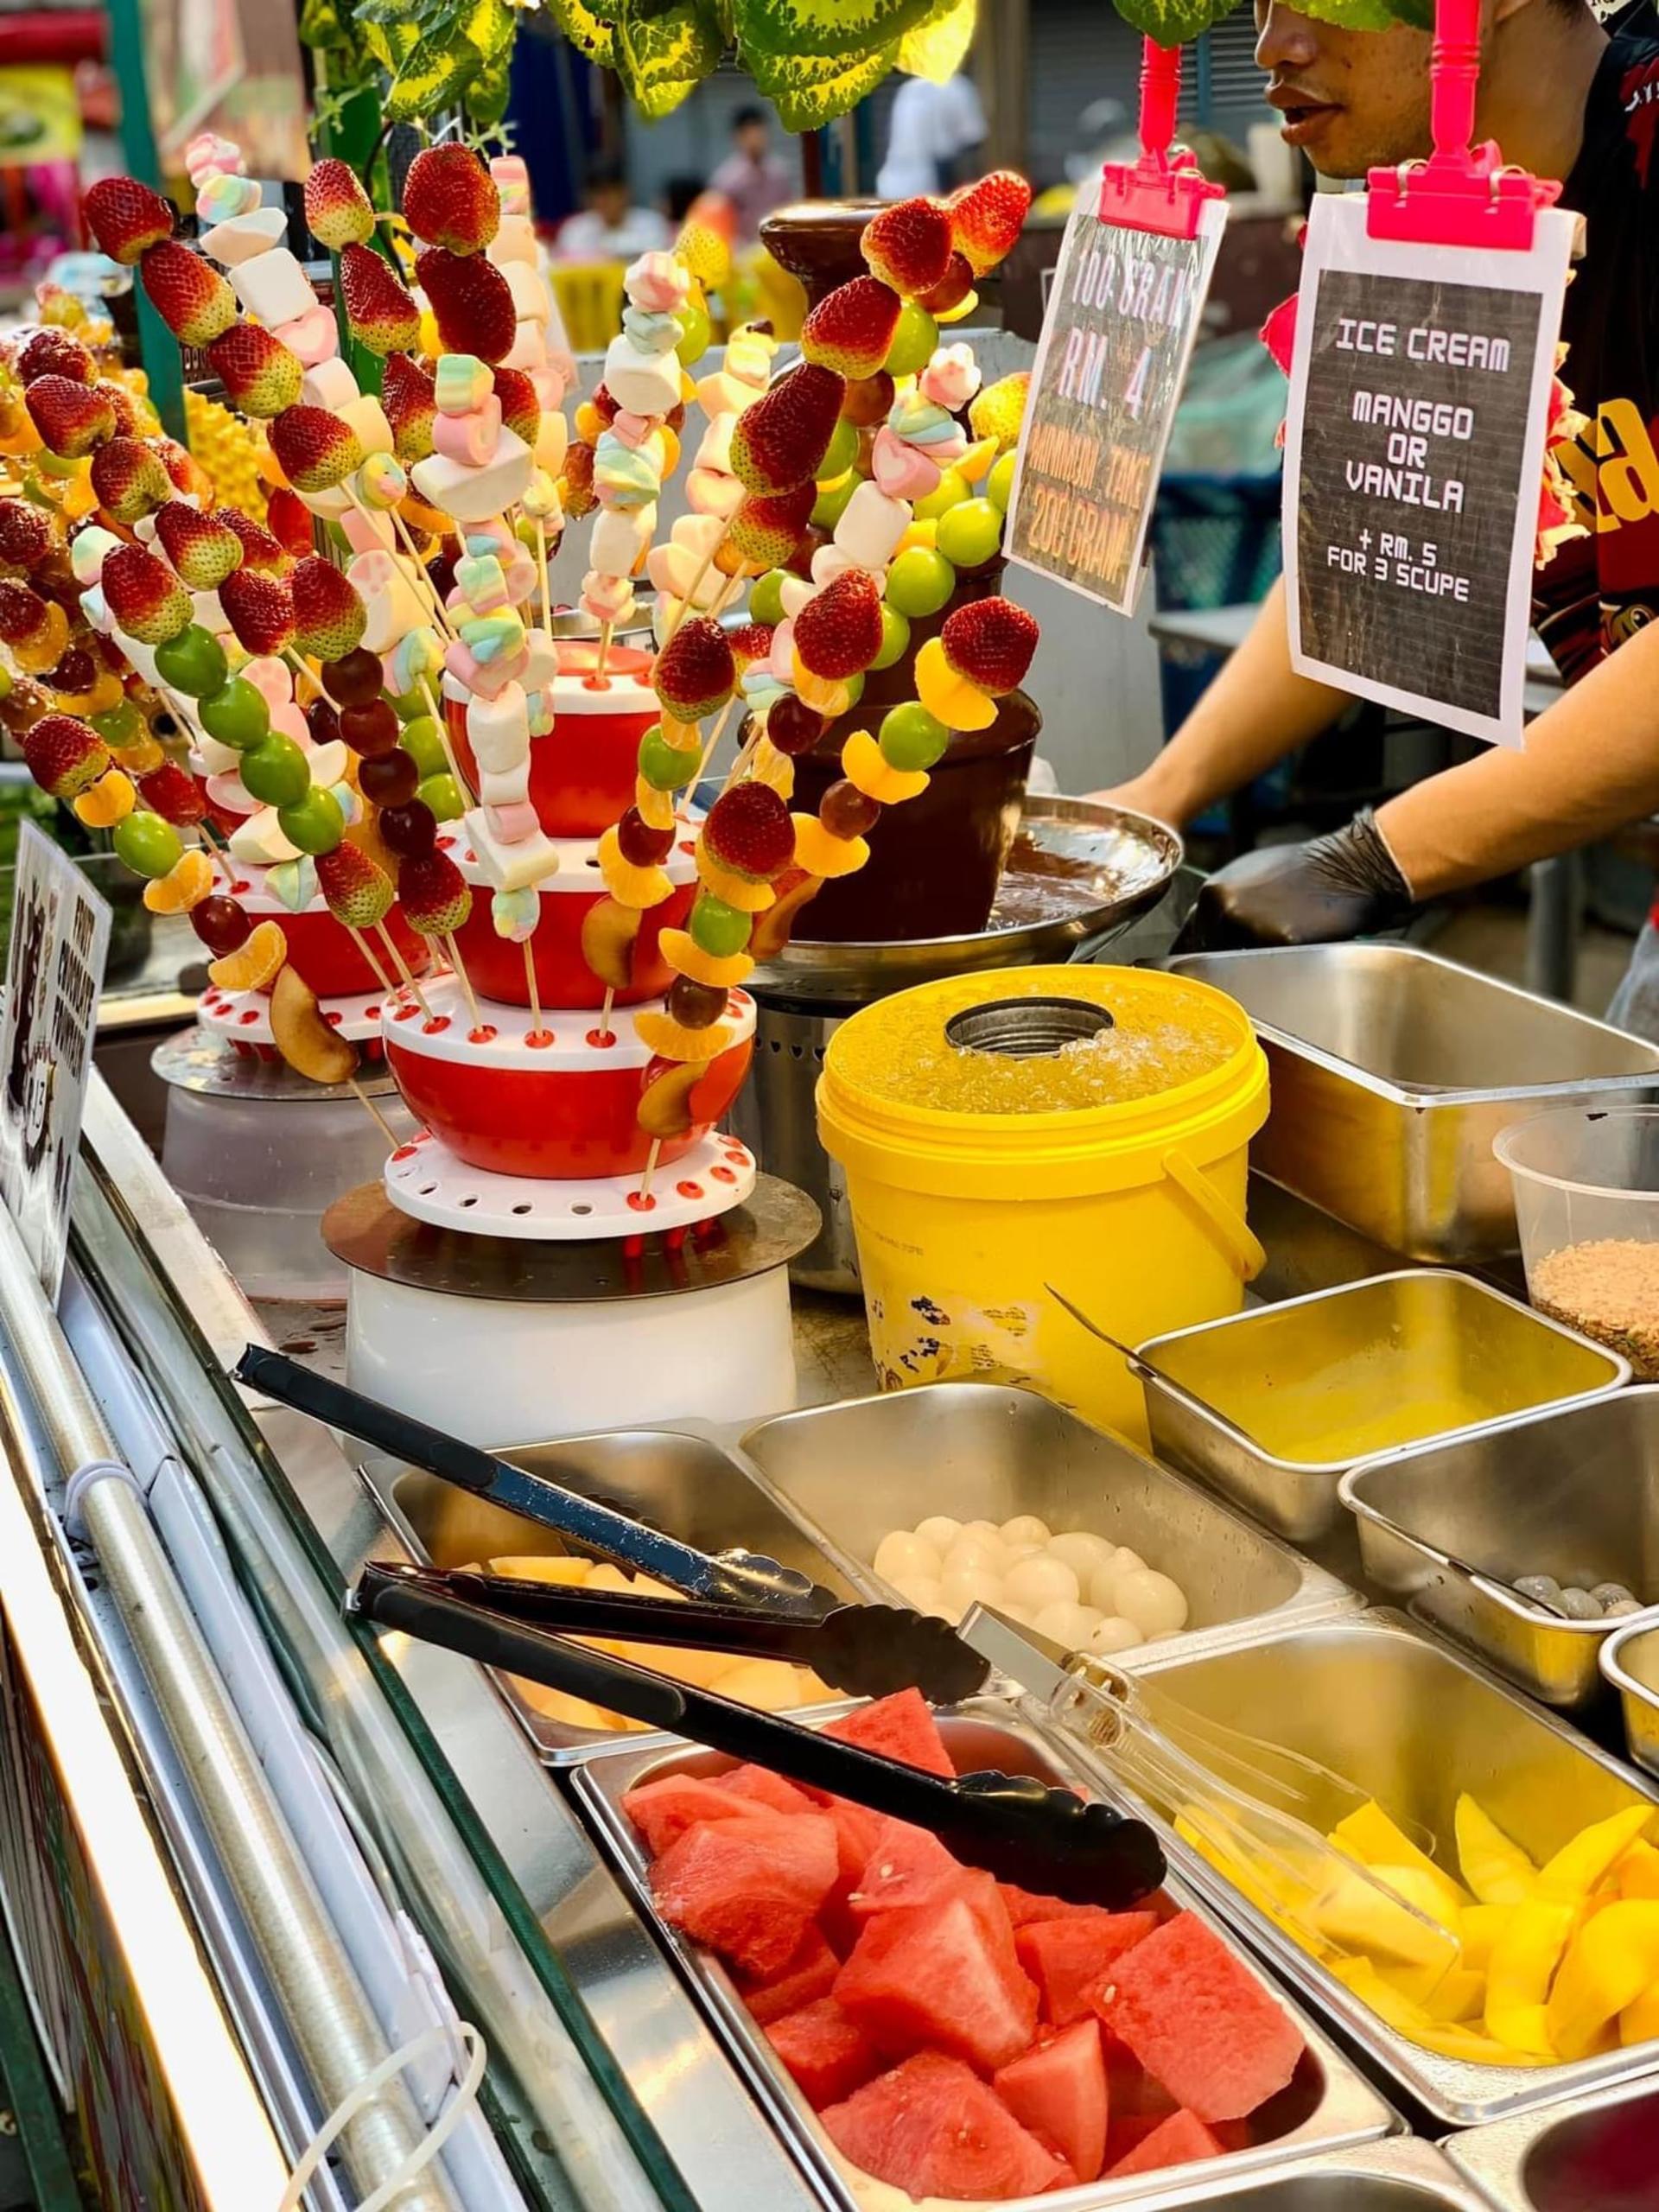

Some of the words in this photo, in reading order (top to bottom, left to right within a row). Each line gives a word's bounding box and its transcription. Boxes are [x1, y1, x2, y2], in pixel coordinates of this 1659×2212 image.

[1072, 249, 1115, 310] 100
[1336, 318, 1397, 356] ICE
[1407, 327, 1510, 372] CREAM
[1124, 346, 1152, 421] 4
[1351, 391, 1474, 441] MANGGO
[1029, 421, 1100, 491] MINIMUM
[1106, 446, 1151, 509] TAKE
[1387, 433, 1428, 469] OR
[1345, 460, 1465, 514] VANILA
[1028, 483, 1070, 557] 200
[1068, 497, 1128, 584] GRAM
[1381, 532, 1413, 562] RM.
[1421, 542, 1437, 567] 5
[1327, 545, 1366, 577] FOR
[1375, 561, 1388, 581] 3
[1395, 563, 1470, 602] SCUPE
